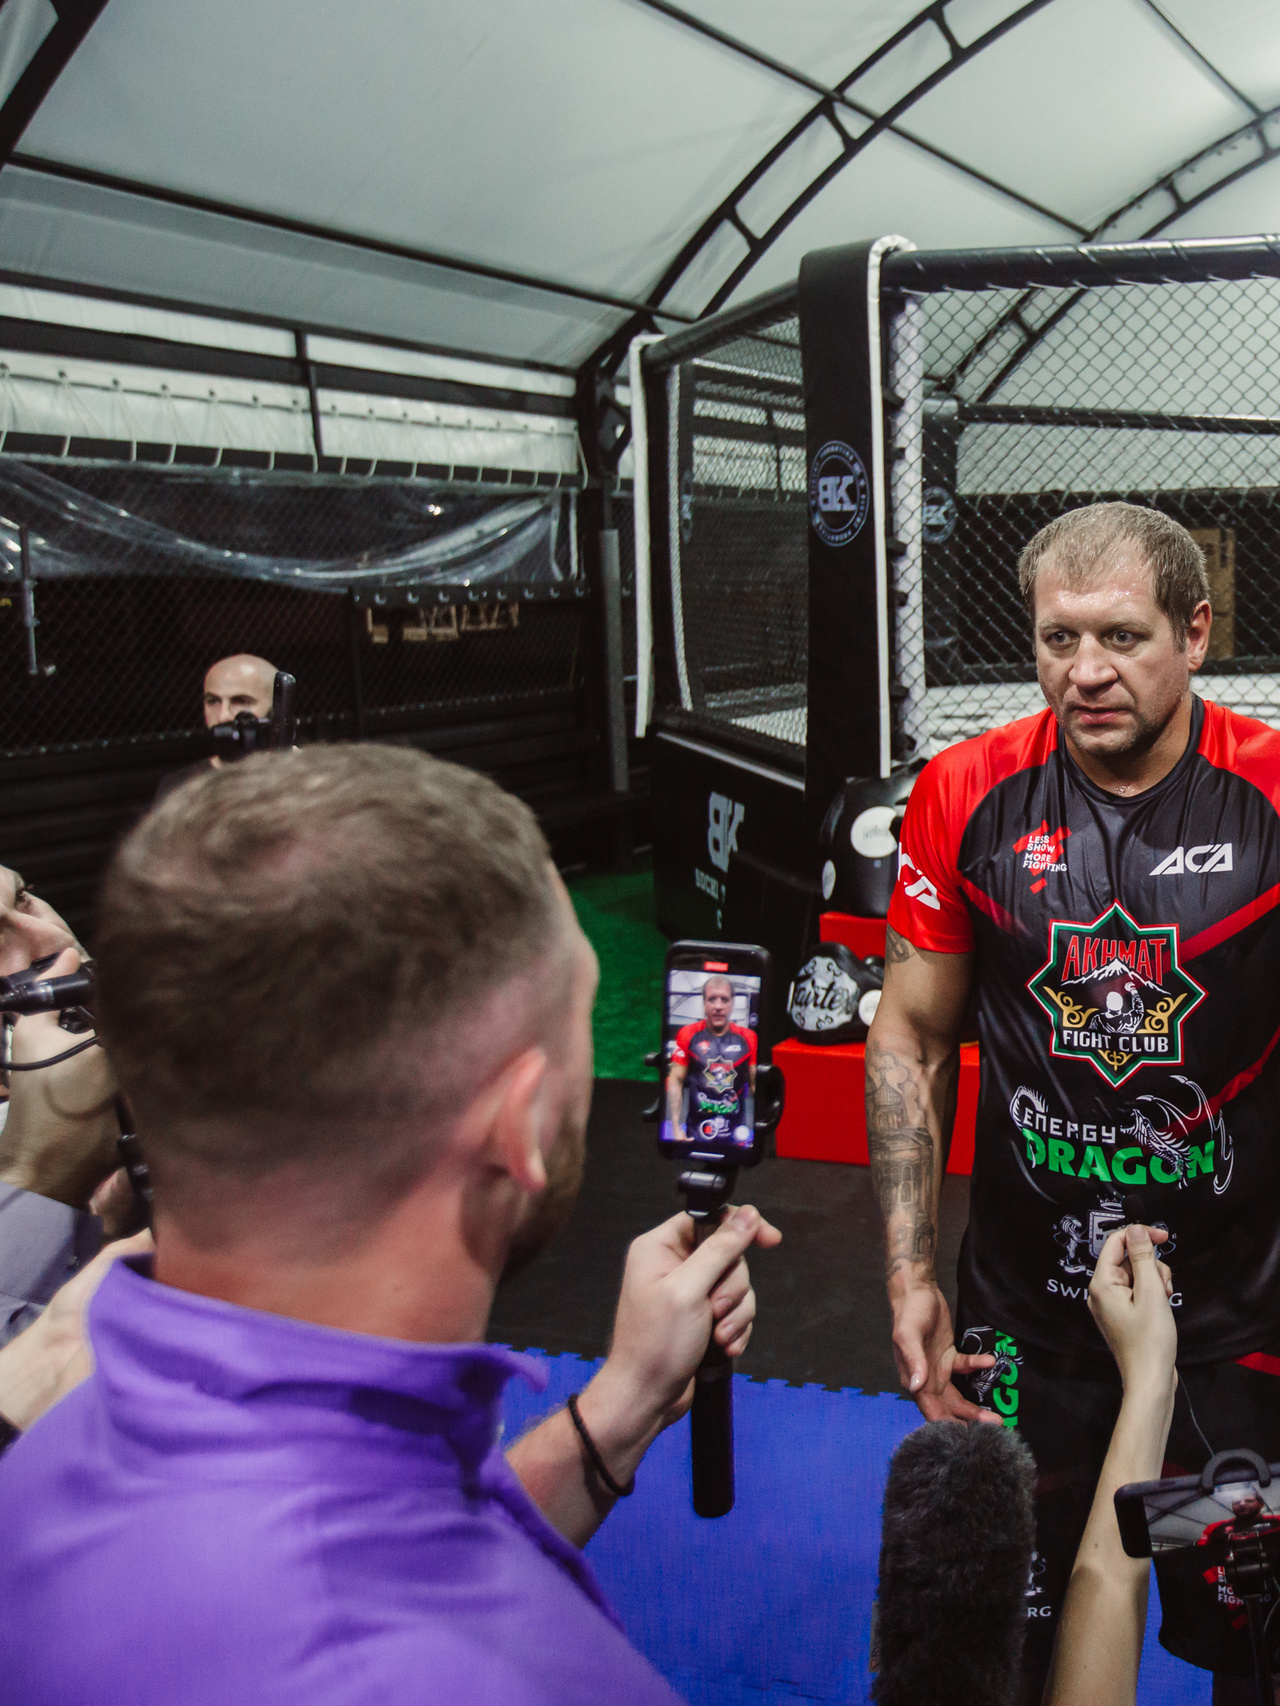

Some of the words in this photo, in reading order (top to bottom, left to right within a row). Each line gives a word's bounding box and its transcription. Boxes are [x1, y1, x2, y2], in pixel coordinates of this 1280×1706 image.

[818, 475, 857, 512] BK
[708, 790, 745, 873] BK
[1028, 835, 1050, 844] LESS
[1024, 852, 1052, 863] MORE
[1027, 843, 1056, 854] SHOW
[1149, 843, 1234, 876] ACA
[1023, 861, 1068, 872] FIGHTING
[1061, 935, 1167, 987] AKHMAT
[1063, 1029, 1112, 1049] FIGHT
[1118, 1036, 1169, 1053] CLUB
[1022, 1107, 1116, 1144] ENERGY
[1022, 1127, 1215, 1185] DRAGON
